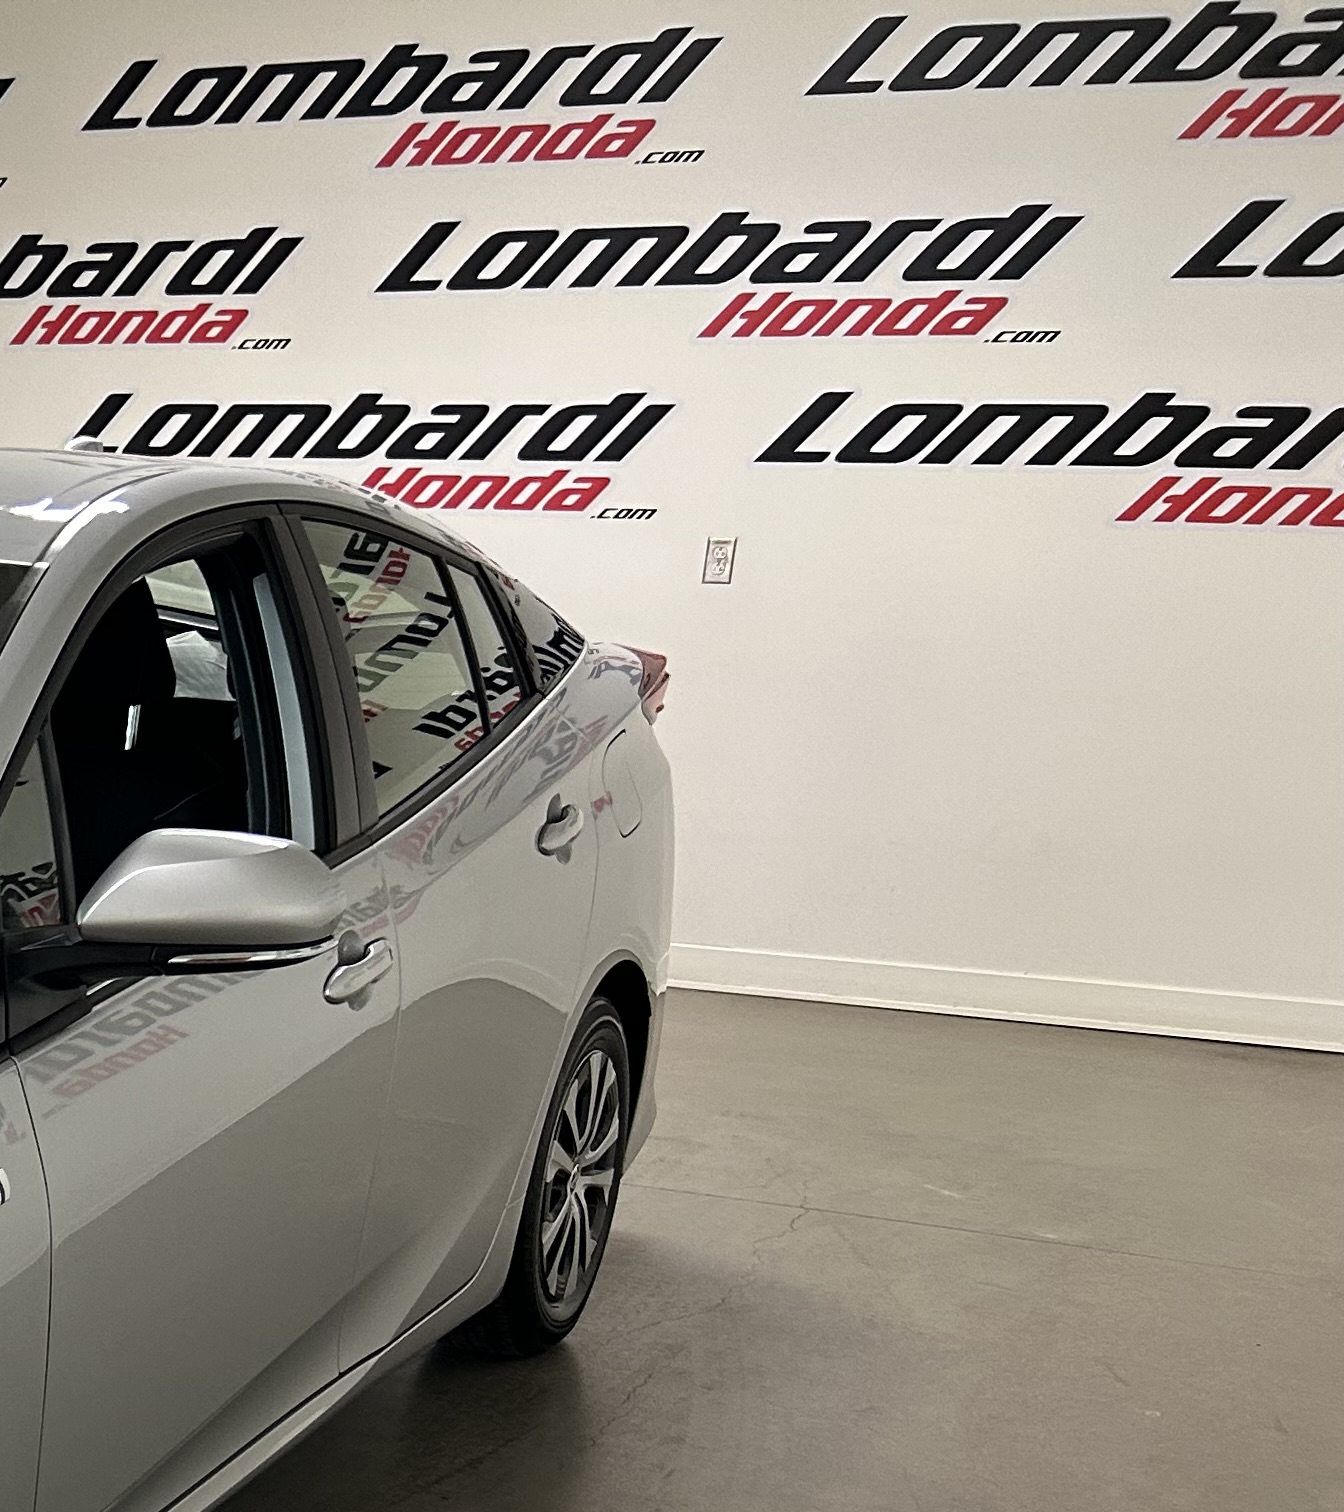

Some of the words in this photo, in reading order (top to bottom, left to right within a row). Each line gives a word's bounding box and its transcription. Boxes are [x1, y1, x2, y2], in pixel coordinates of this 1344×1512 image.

[805, 0, 1344, 96] Lomba
[81, 27, 724, 131] Lombardi
[374, 113, 657, 168] Honda
[374, 204, 1084, 294] Lombardi
[9, 303, 250, 346] Honda
[697, 289, 1010, 339] Honda
[72, 393, 675, 461] Lombardi
[360, 466, 611, 512] Honda
